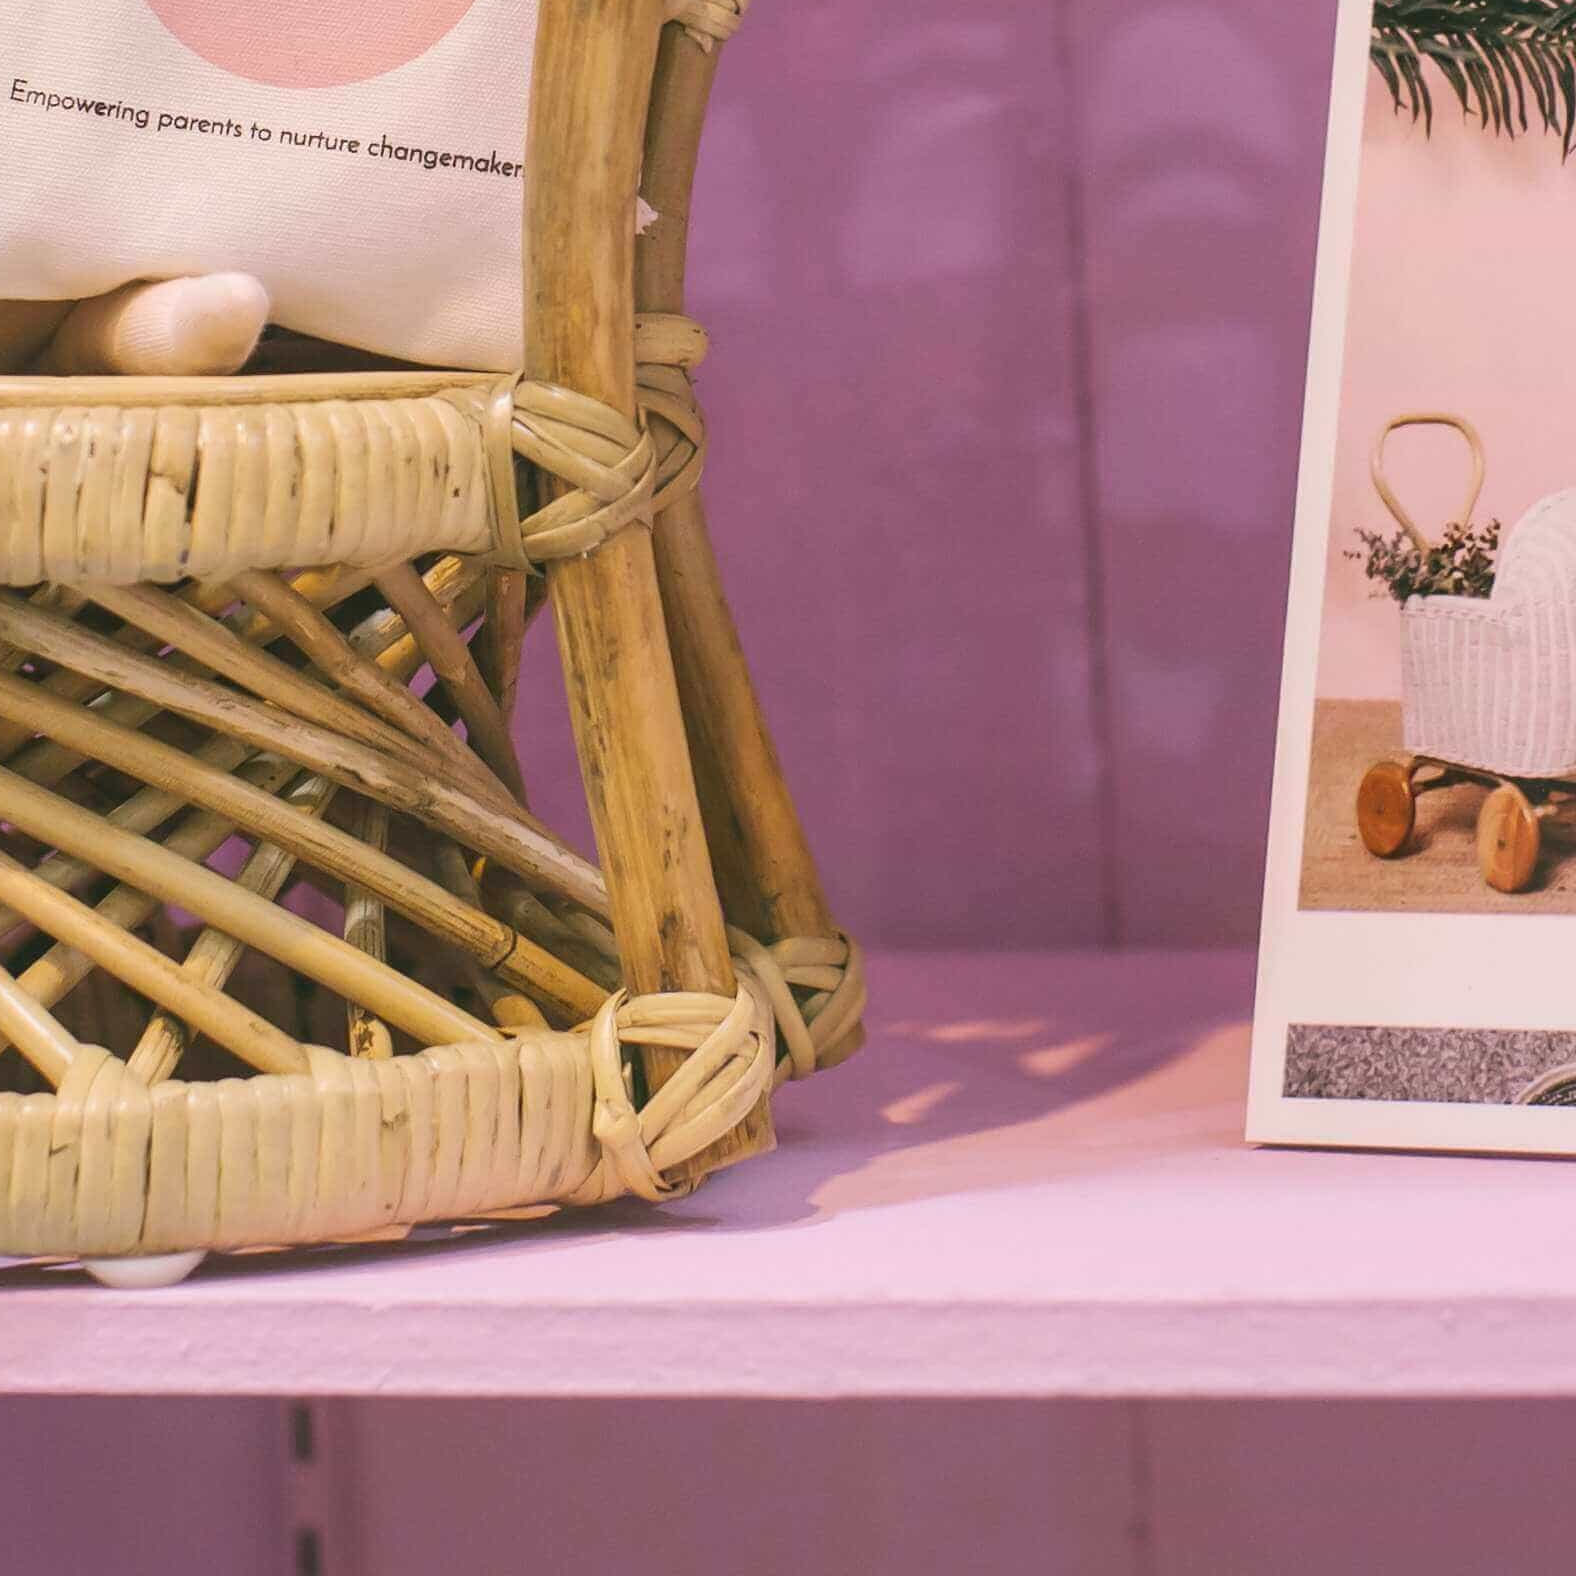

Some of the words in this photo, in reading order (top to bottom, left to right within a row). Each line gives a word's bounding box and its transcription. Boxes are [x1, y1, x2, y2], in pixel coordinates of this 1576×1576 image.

[9, 78, 151, 129] Empowering
[156, 111, 243, 138] parents
[250, 122, 273, 142] to
[279, 129, 361, 154] nurture
[367, 134, 525, 179] changemaker
